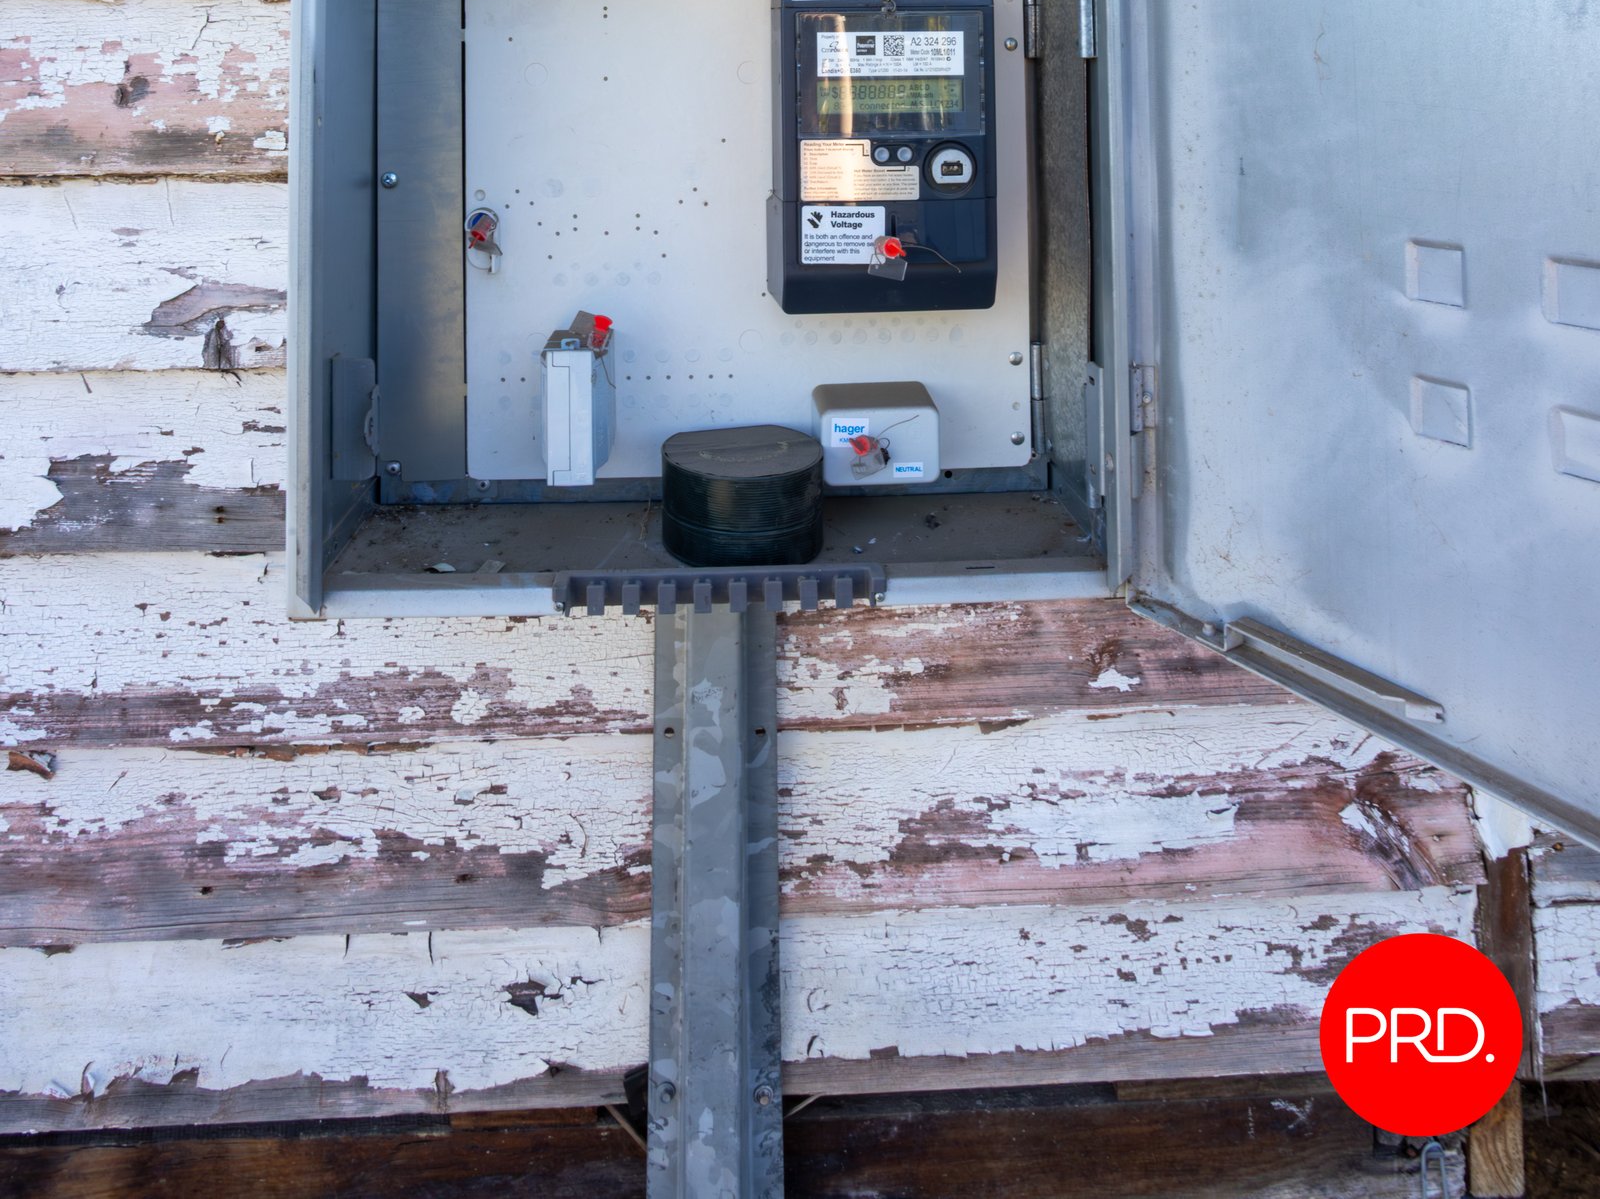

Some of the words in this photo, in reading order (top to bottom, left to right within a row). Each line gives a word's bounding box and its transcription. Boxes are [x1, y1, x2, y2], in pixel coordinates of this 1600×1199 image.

[910, 36, 922, 46] A2
[924, 36, 939, 46] 324
[941, 36, 957, 46] 296
[830, 210, 876, 219] Hazardous
[830, 220, 863, 230] Voltage
[834, 423, 866, 436] hager
